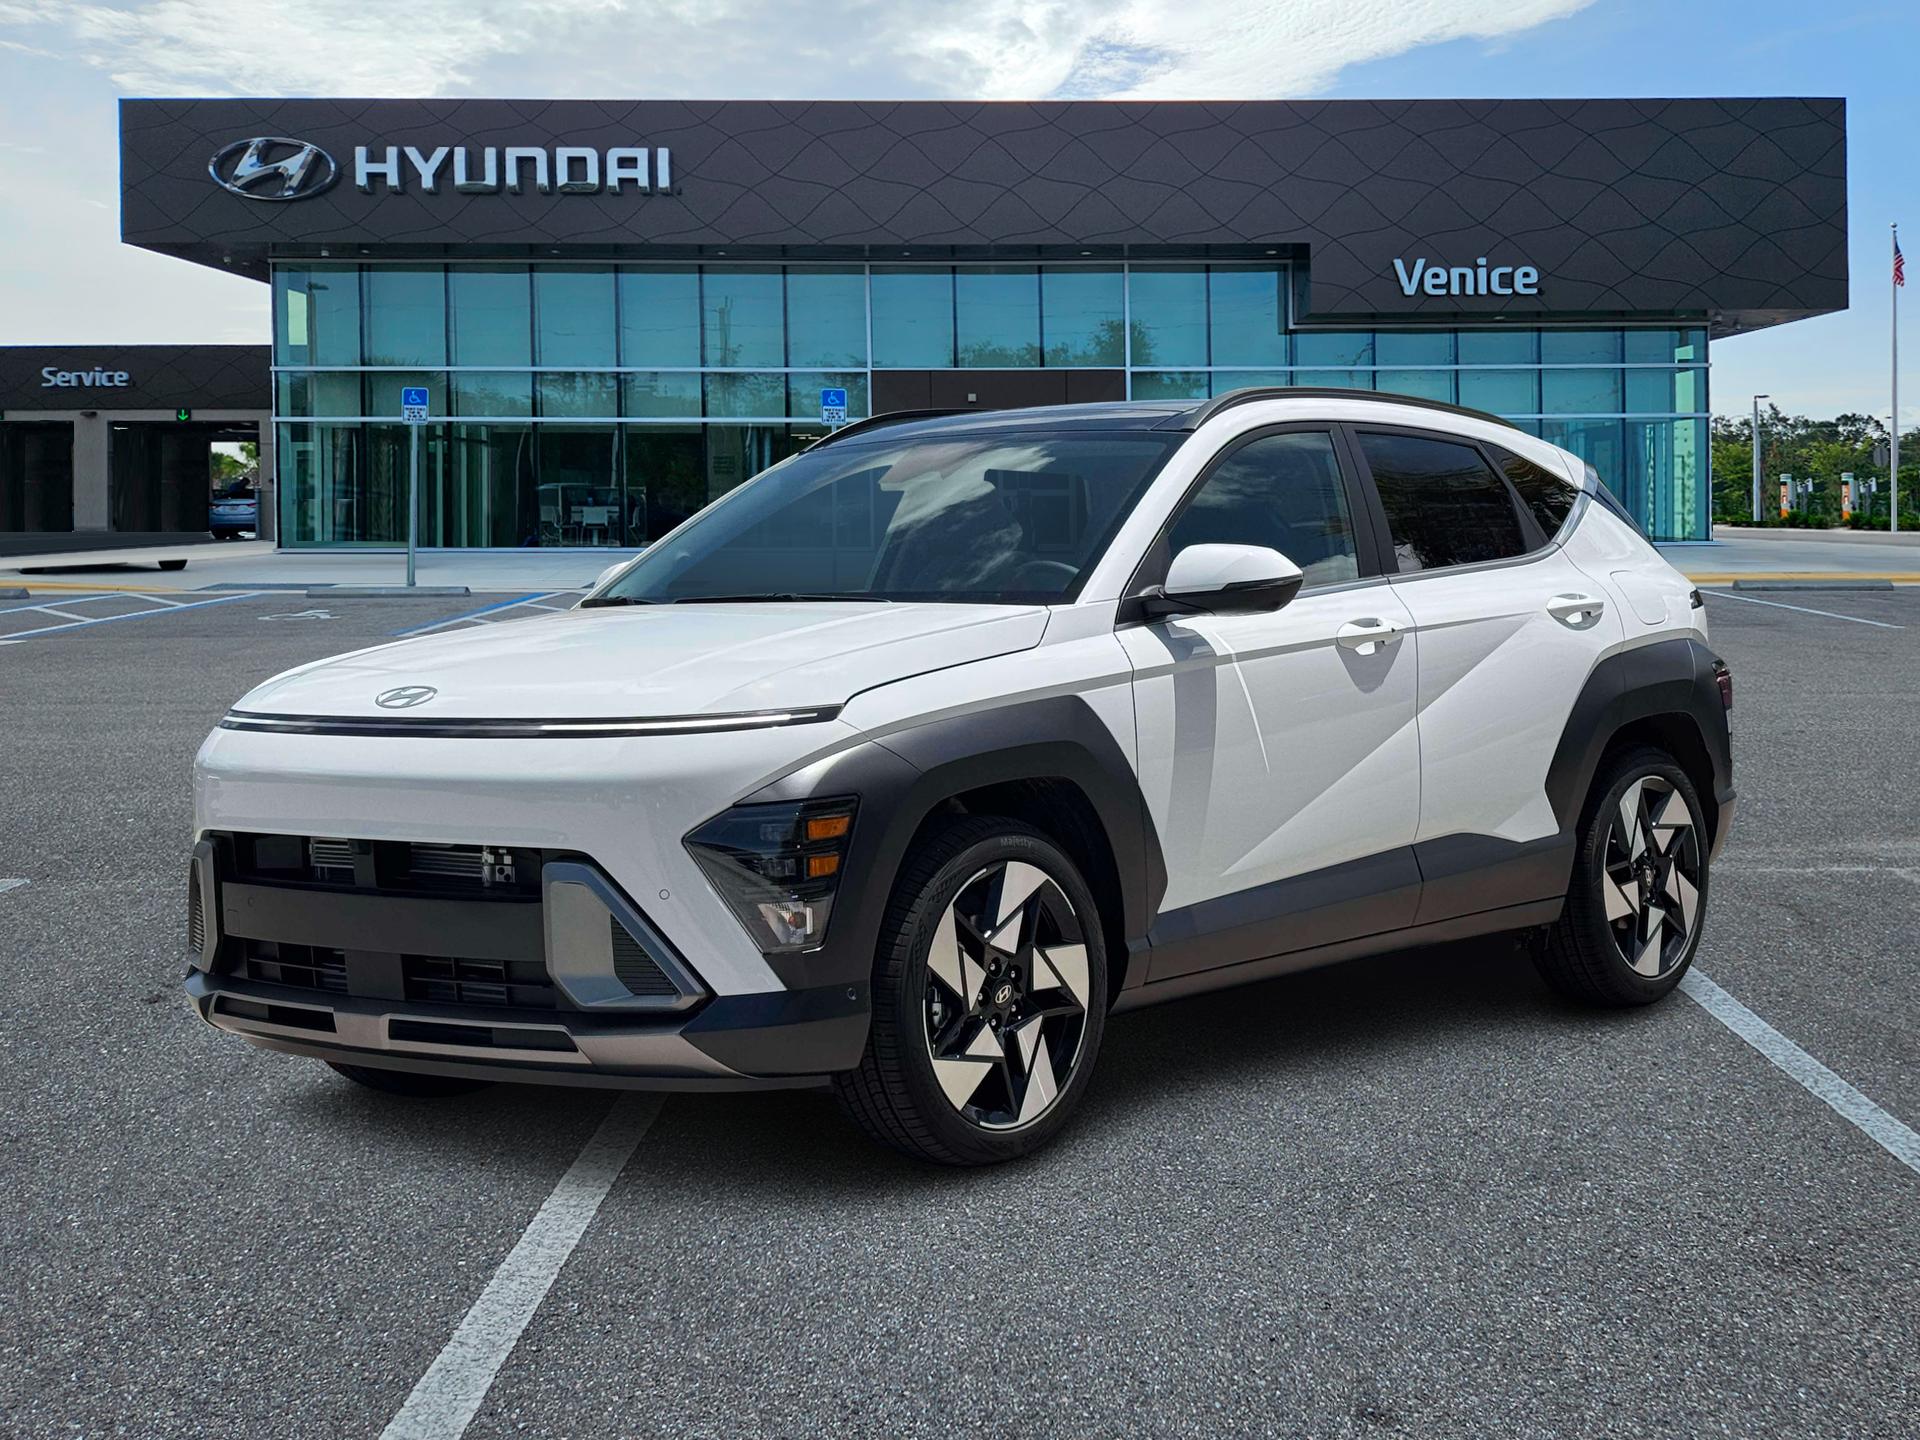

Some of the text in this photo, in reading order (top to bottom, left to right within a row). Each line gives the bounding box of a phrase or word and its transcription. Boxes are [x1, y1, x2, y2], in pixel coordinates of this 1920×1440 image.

[354, 146, 672, 194] HYUNDAI
[1393, 257, 1539, 295] Venice
[41, 367, 129, 387] Service
